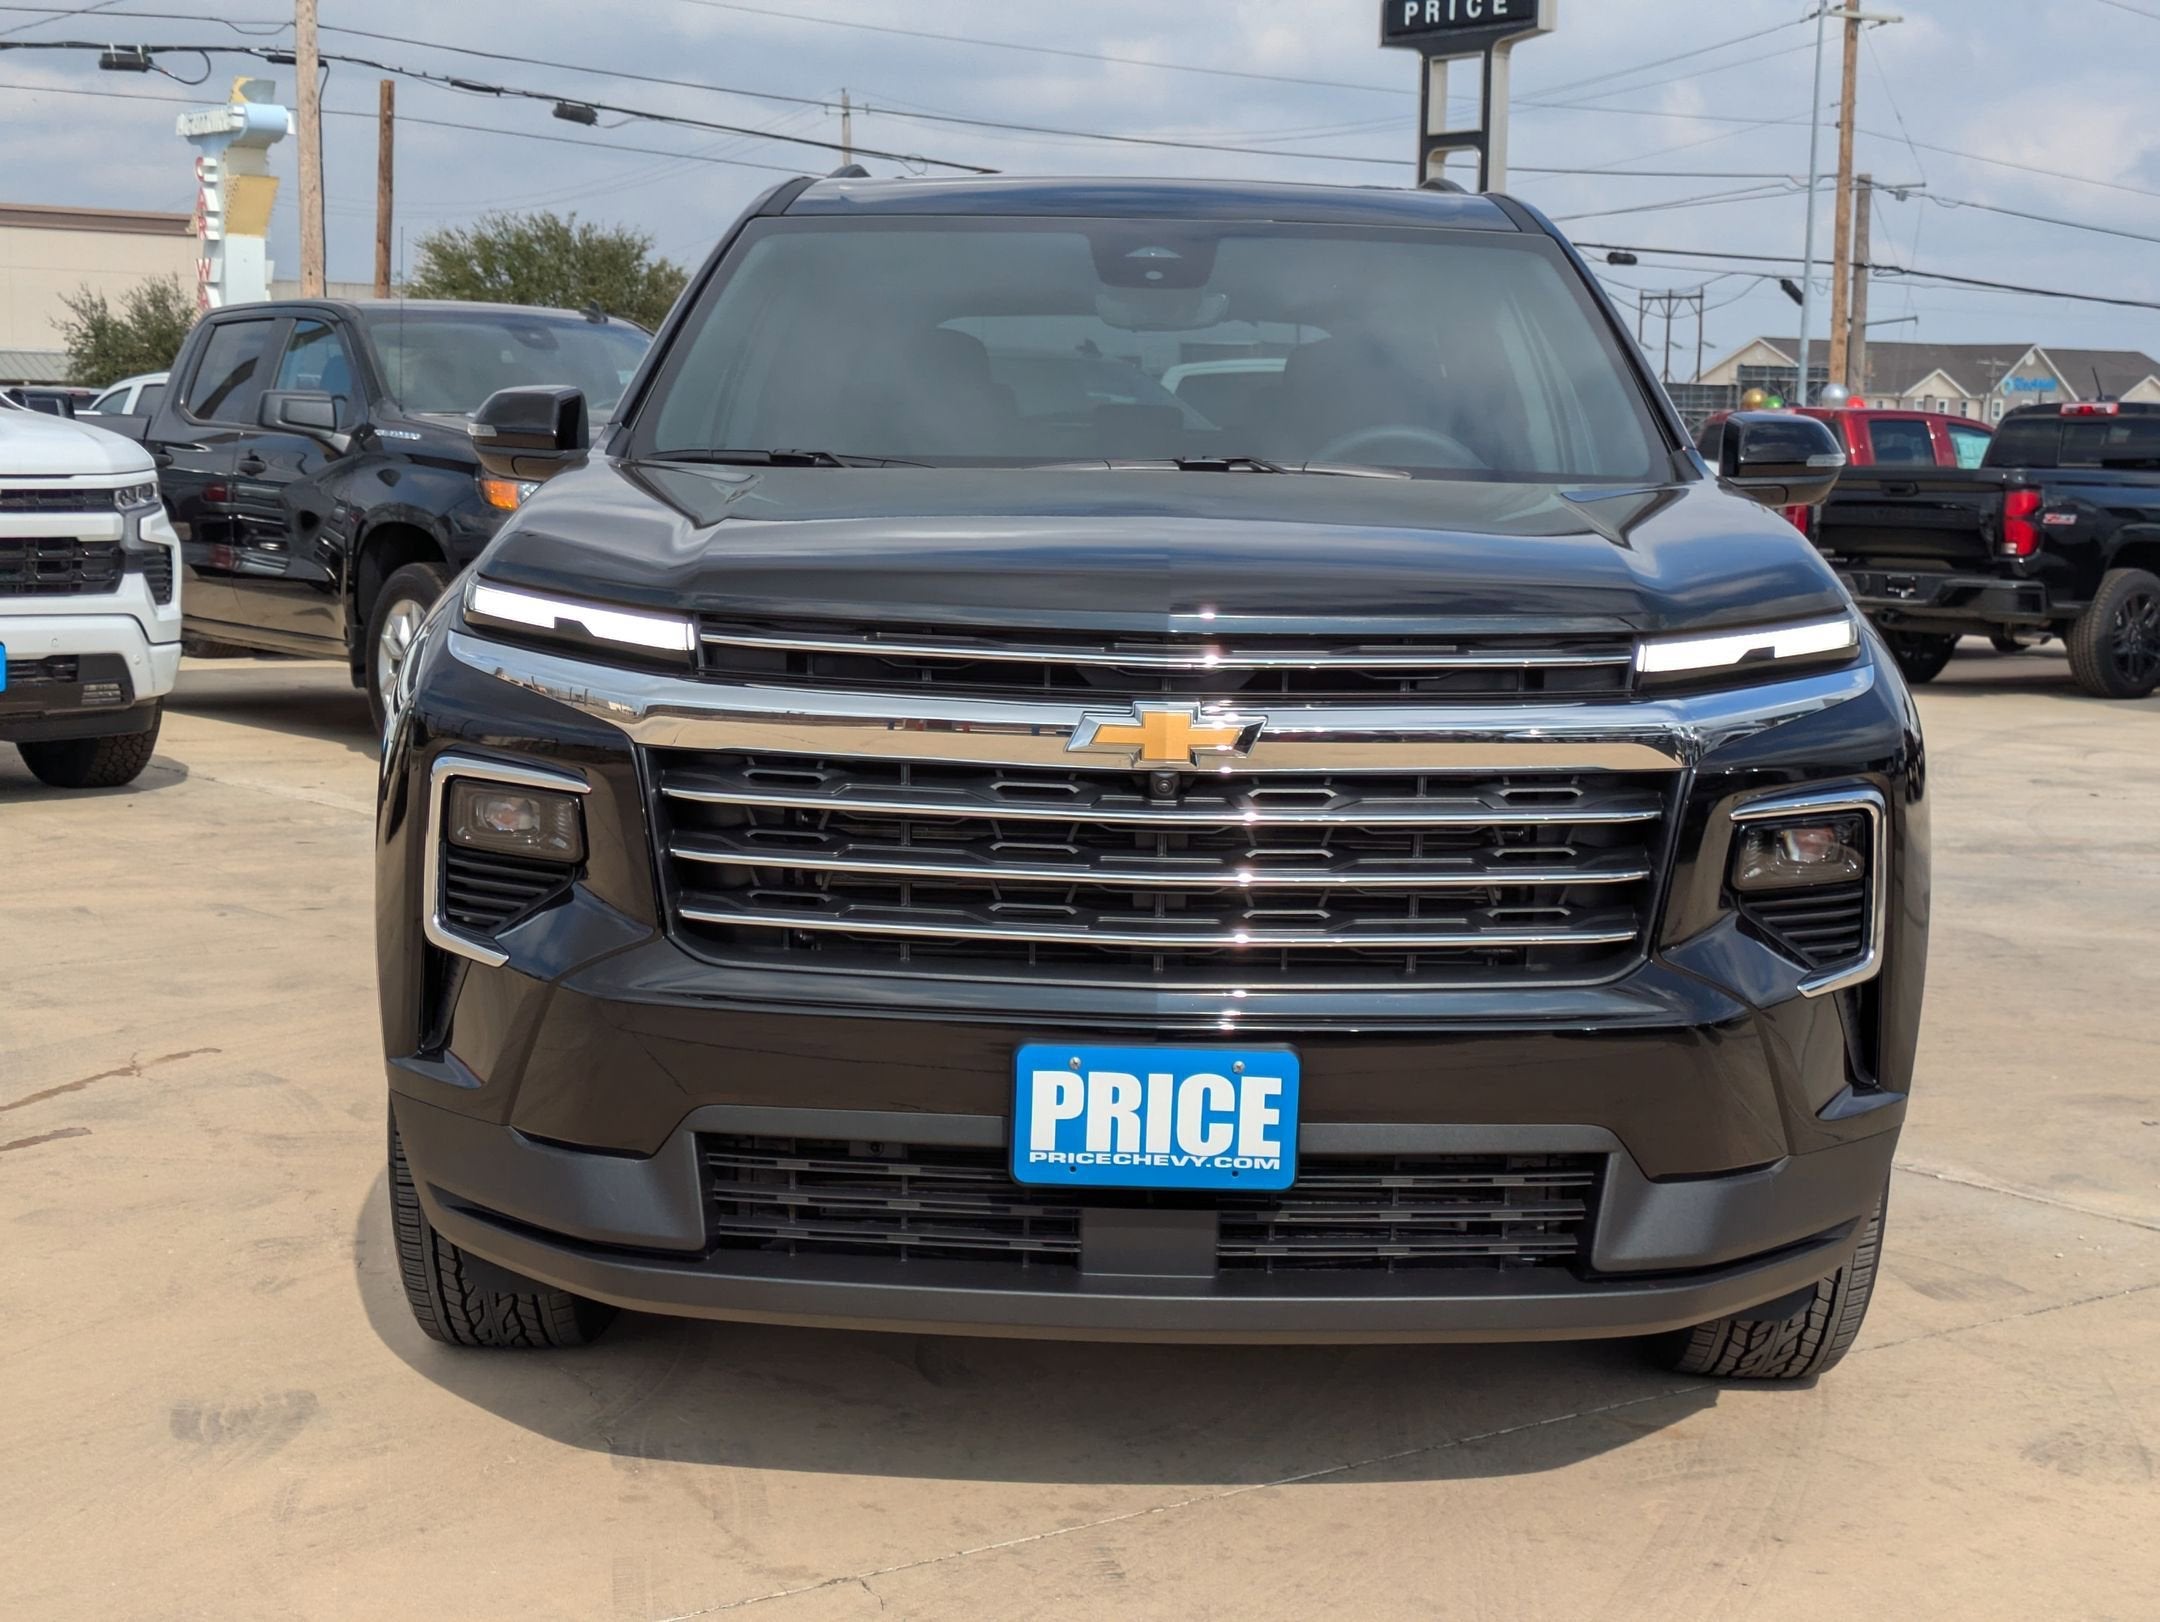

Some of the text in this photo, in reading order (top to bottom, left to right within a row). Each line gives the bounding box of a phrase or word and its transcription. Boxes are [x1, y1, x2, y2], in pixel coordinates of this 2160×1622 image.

[1404, 0, 1508, 26] PRICE
[194, 156, 219, 240] CAR
[1030, 1070, 1282, 1158] PRICE
[1029, 1151, 1281, 1171] PRICECHEVY.COM
